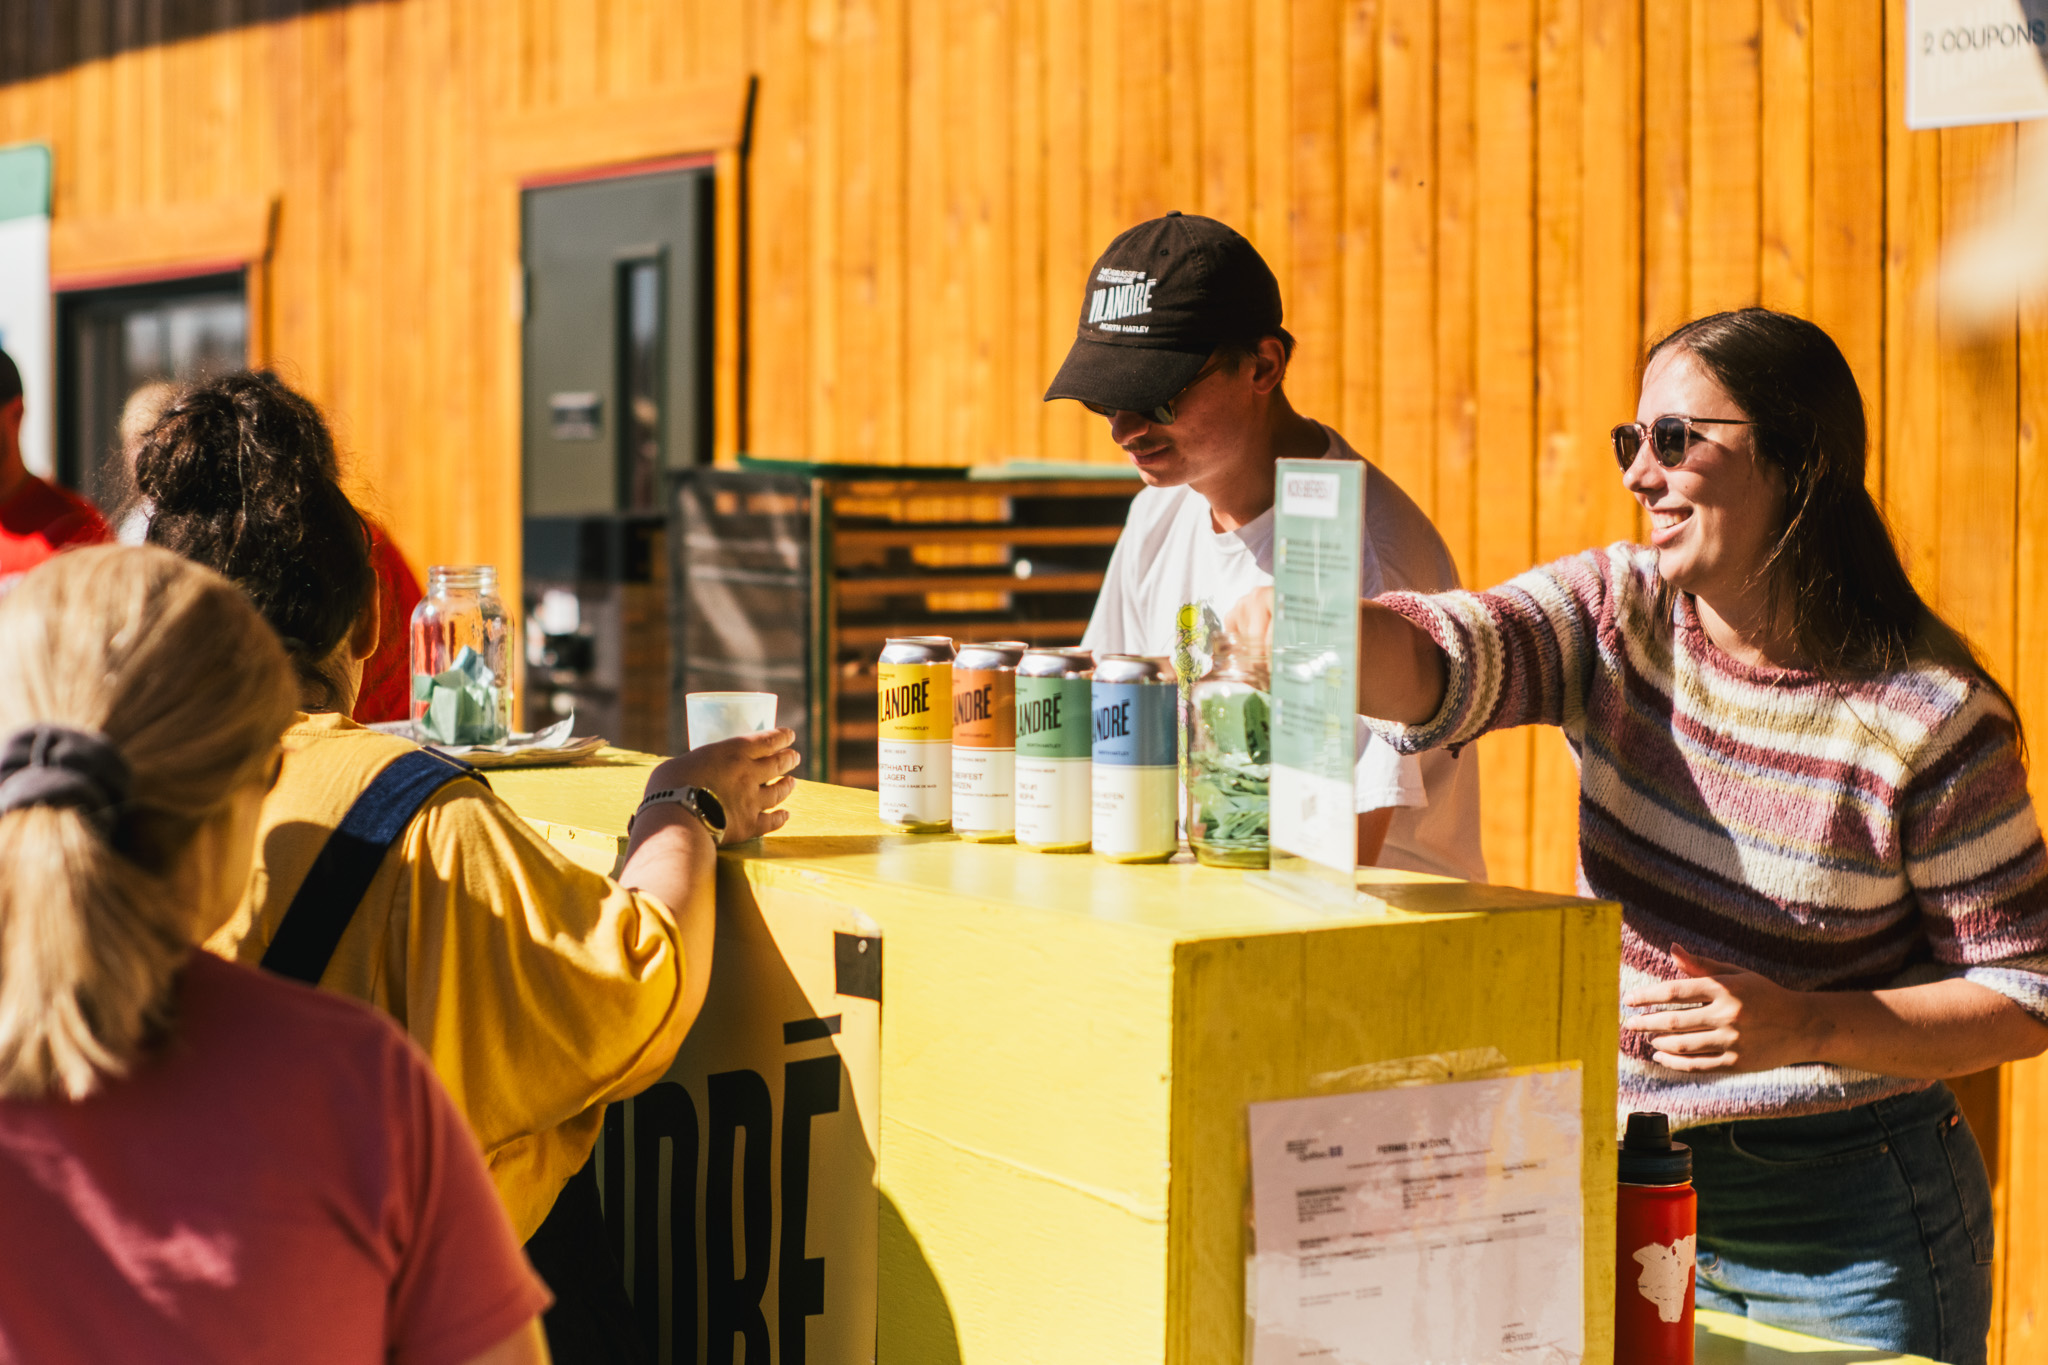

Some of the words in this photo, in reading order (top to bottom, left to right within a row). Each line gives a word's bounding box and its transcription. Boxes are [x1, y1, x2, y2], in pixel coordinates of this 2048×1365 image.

[1941, 18, 2047, 54] COUPONS
[1122, 324, 1149, 333] HATLEY
[893, 765, 924, 773] HATLEY
[884, 773, 906, 781] LAGER
